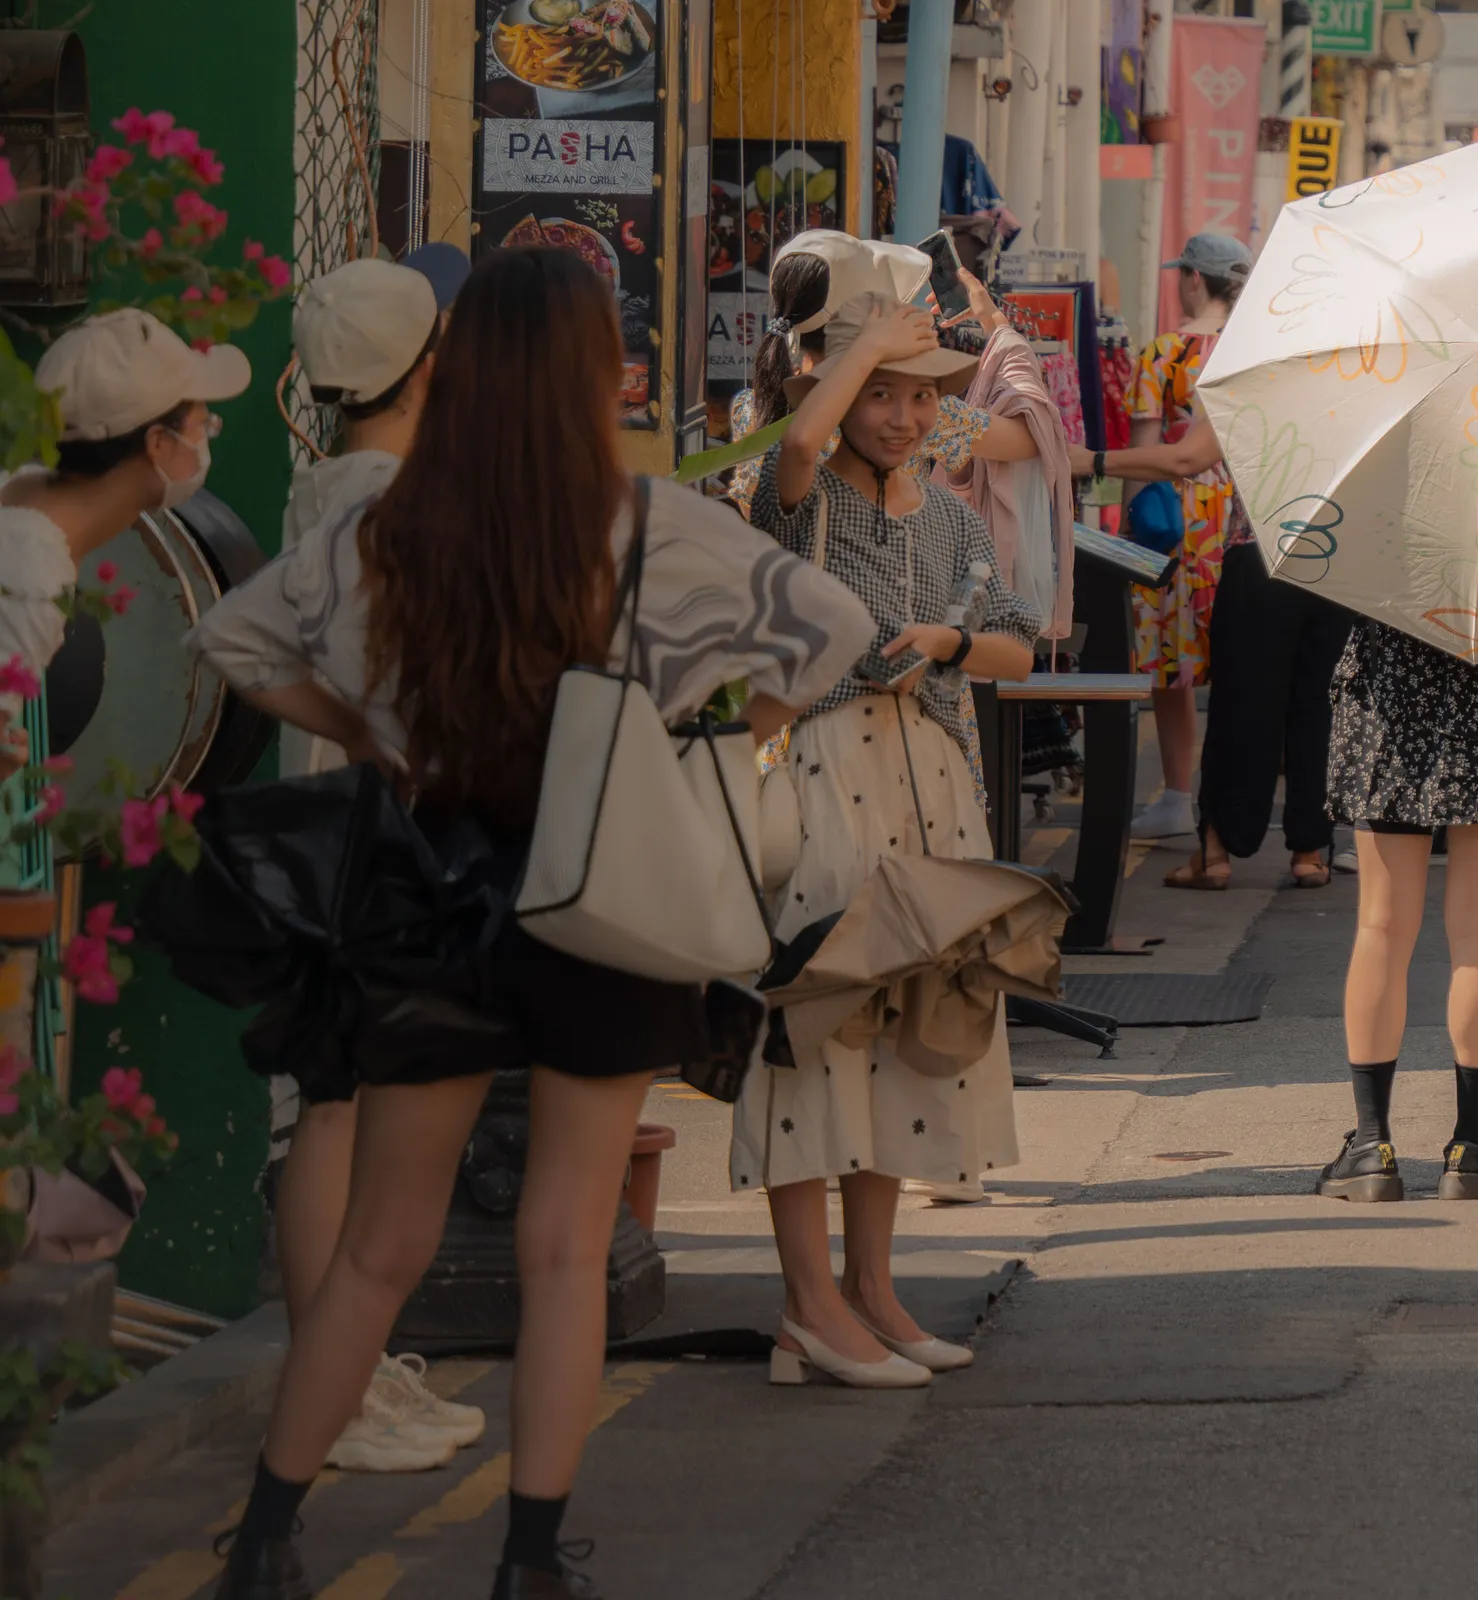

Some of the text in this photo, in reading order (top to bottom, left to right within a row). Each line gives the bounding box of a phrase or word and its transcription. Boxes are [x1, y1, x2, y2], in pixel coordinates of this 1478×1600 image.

[508, 131, 637, 166] PASHA
[525, 173, 618, 187] MEZZA AND GRILL
